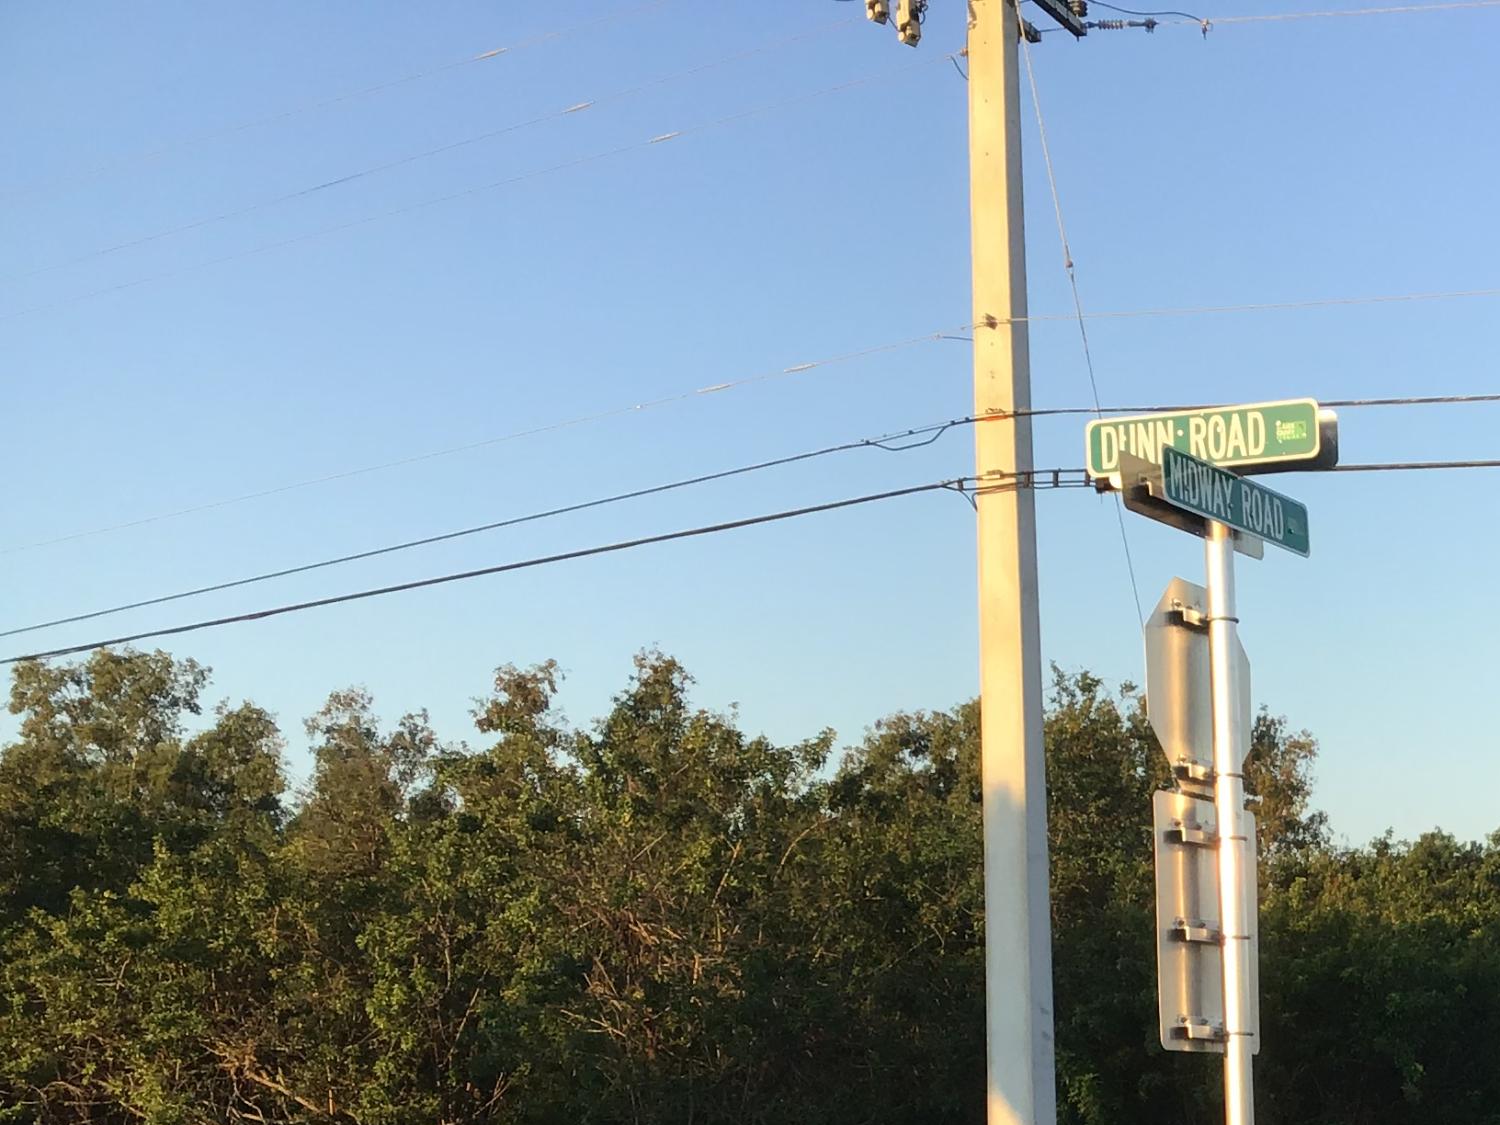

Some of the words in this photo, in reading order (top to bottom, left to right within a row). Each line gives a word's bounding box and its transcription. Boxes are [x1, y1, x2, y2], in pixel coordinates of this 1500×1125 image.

[1101, 420, 1174, 469] DUNN
[1189, 411, 1265, 460] ROAD
[1169, 453, 1233, 519] MIDWAY
[1241, 483, 1284, 540] ROAD
